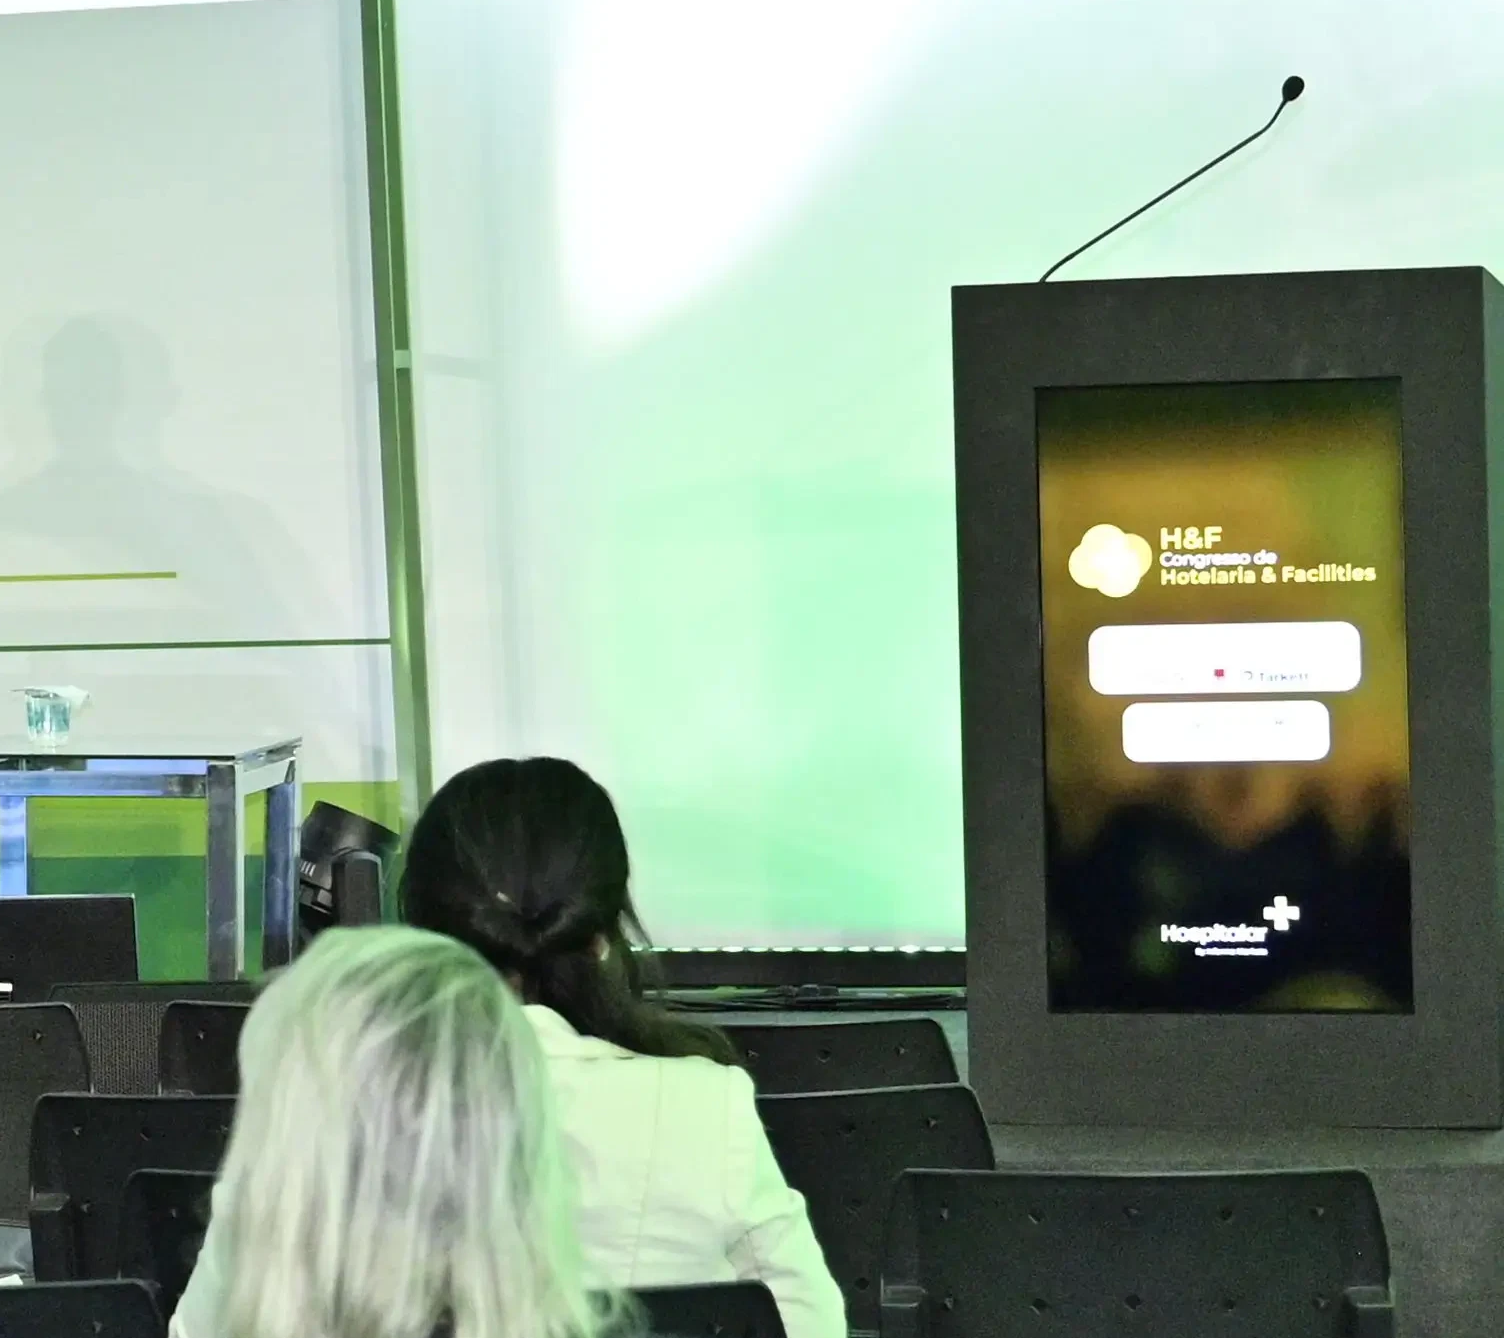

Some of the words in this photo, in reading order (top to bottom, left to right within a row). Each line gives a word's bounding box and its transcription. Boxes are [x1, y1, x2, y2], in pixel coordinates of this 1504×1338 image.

[1160, 526, 1223, 550] H&F
[1160, 566, 1256, 585] Hotelaria
[1261, 567, 1276, 583] &
[1281, 563, 1376, 582] Facilities
